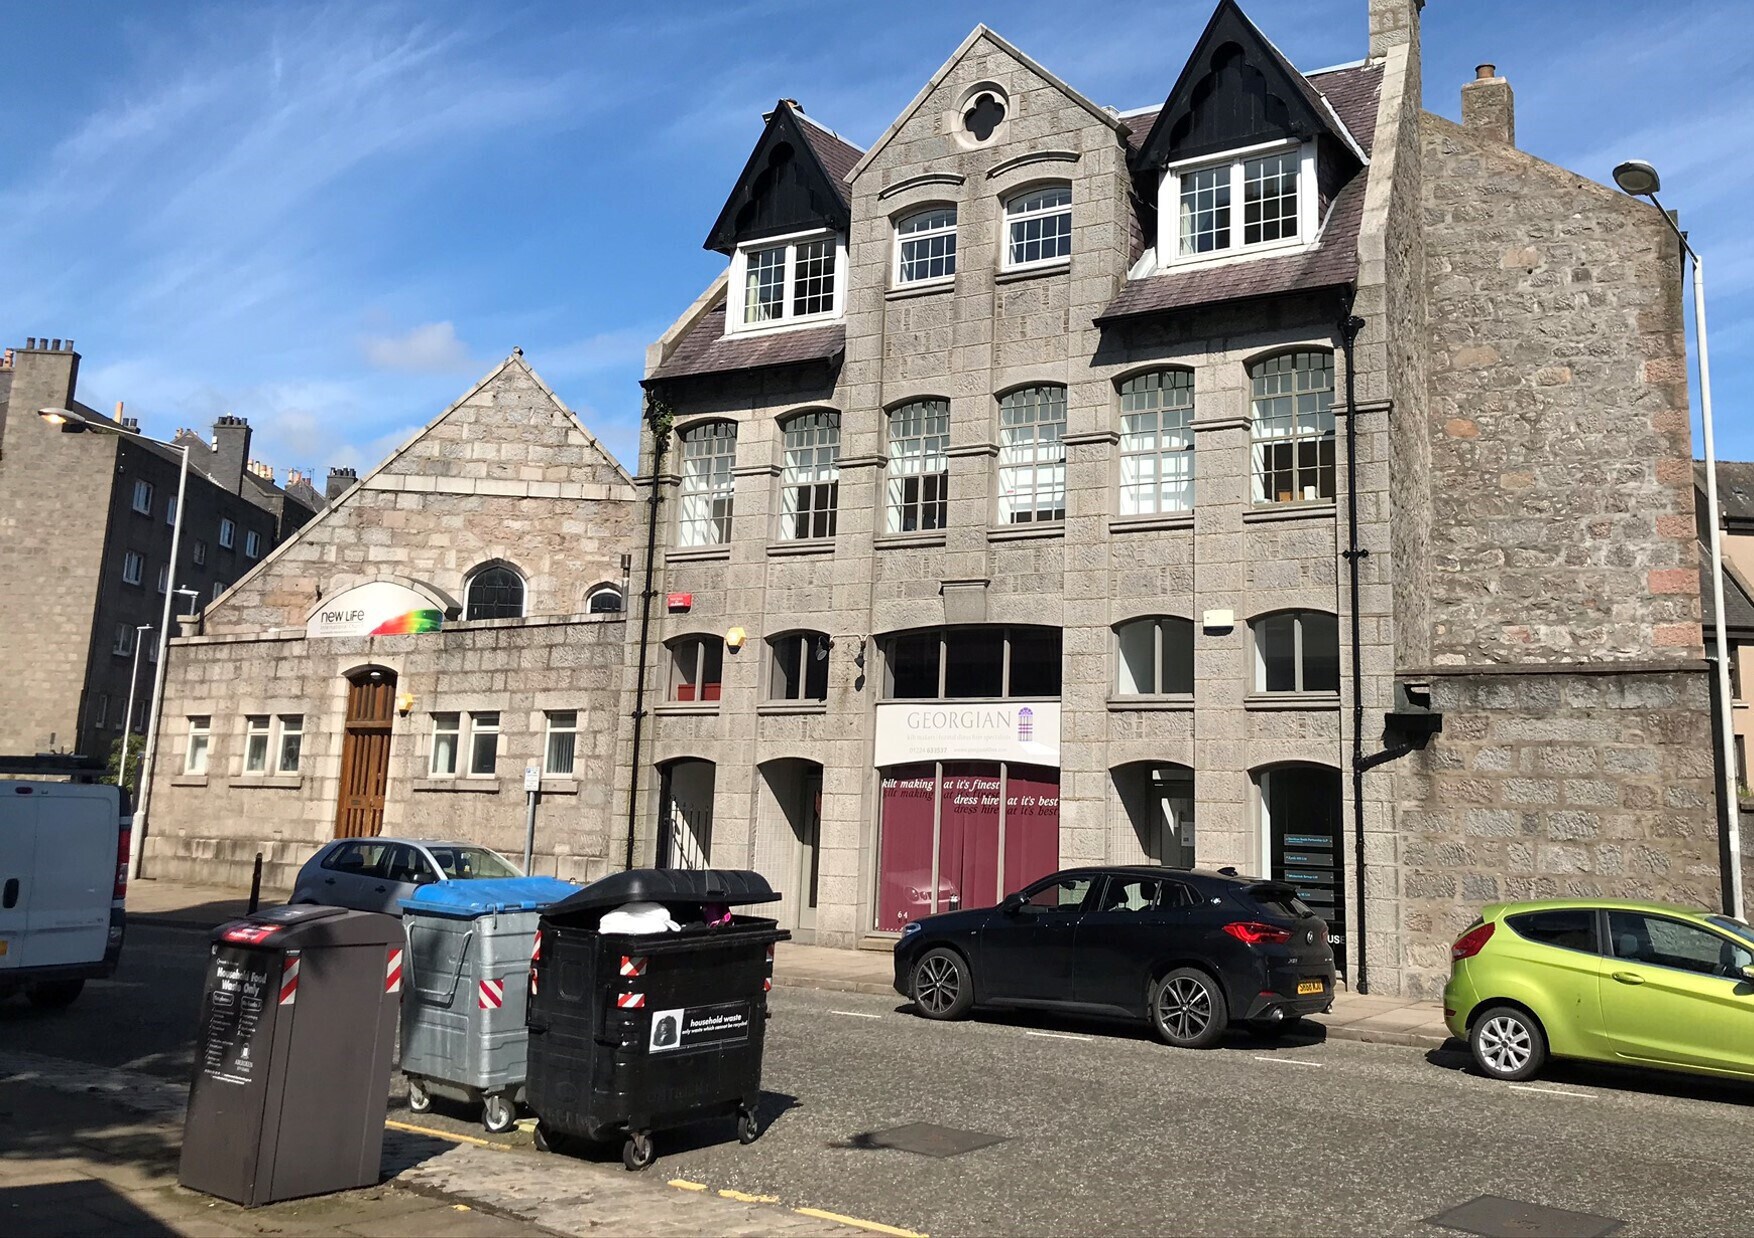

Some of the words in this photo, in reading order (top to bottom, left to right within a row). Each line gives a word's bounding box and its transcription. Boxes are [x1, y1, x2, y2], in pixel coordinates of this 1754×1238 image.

[907, 711, 1011, 729] GEORGIAN
[881, 778, 897, 788] kilt
[900, 779, 934, 791] making
[943, 780, 953, 789] at
[956, 780, 970, 789] it's
[969, 779, 1000, 792] finest
[954, 795, 978, 805] dress
[981, 795, 1000, 805] hire
[1007, 797, 1018, 806] at
[1021, 796, 1035, 806] it's
[1038, 796, 1059, 806] best
[216, 966, 250, 981] Household
[251, 972, 267, 984] Food
[221, 979, 242, 992] Waste
[243, 983, 260, 997] Only
[690, 1015, 723, 1027] household
[723, 1014, 742, 1023] waste
